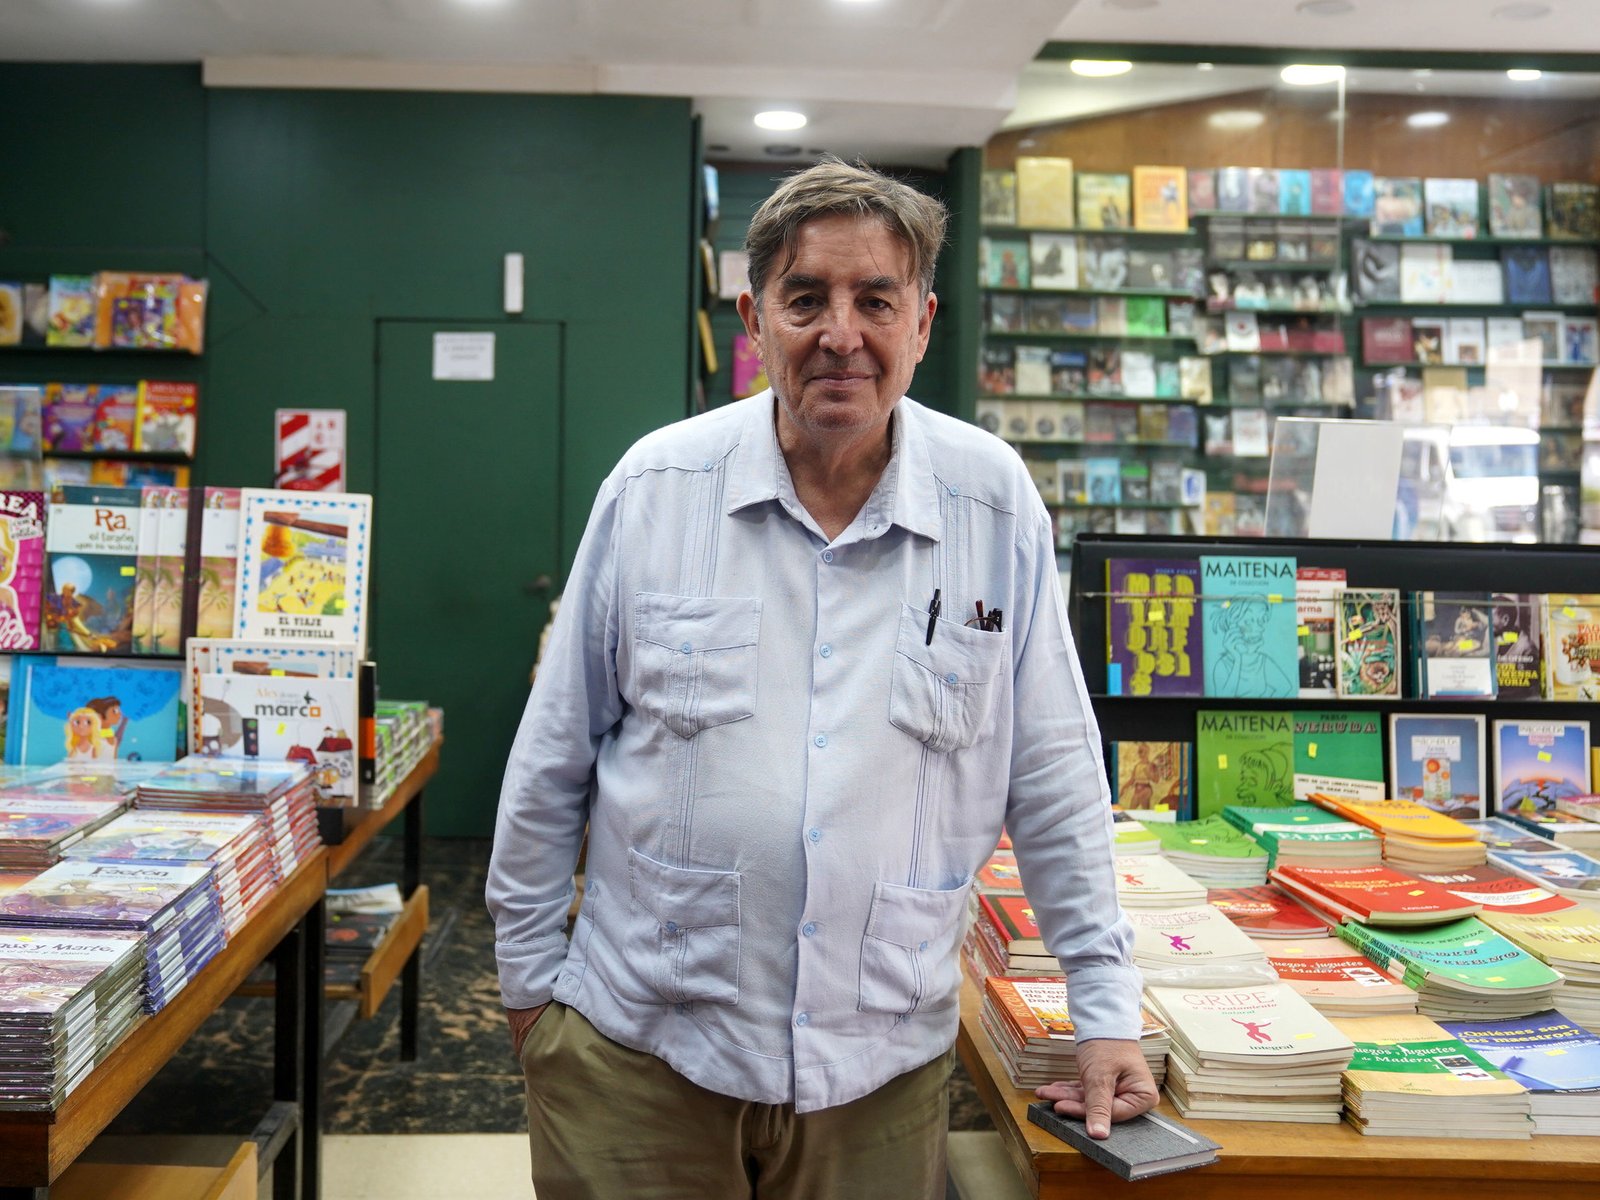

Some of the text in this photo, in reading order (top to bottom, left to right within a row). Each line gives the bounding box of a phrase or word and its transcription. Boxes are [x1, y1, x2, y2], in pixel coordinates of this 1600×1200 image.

[1205, 561, 1294, 579] MAITENA
[278, 617, 322, 626] EL VIAJE
[264, 628, 276, 636] DE
[255, 703, 321, 717] marco
[1200, 714, 1290, 733] MAITENA
[1295, 722, 1378, 734] NERUDA
[1183, 991, 1275, 1006] GRIPE
[1218, 1003, 1277, 1011] tratamiento
[1538, 1024, 1571, 1032] son
[1493, 1029, 1580, 1043] maestros?
[1355, 1047, 1391, 1056] uegos
